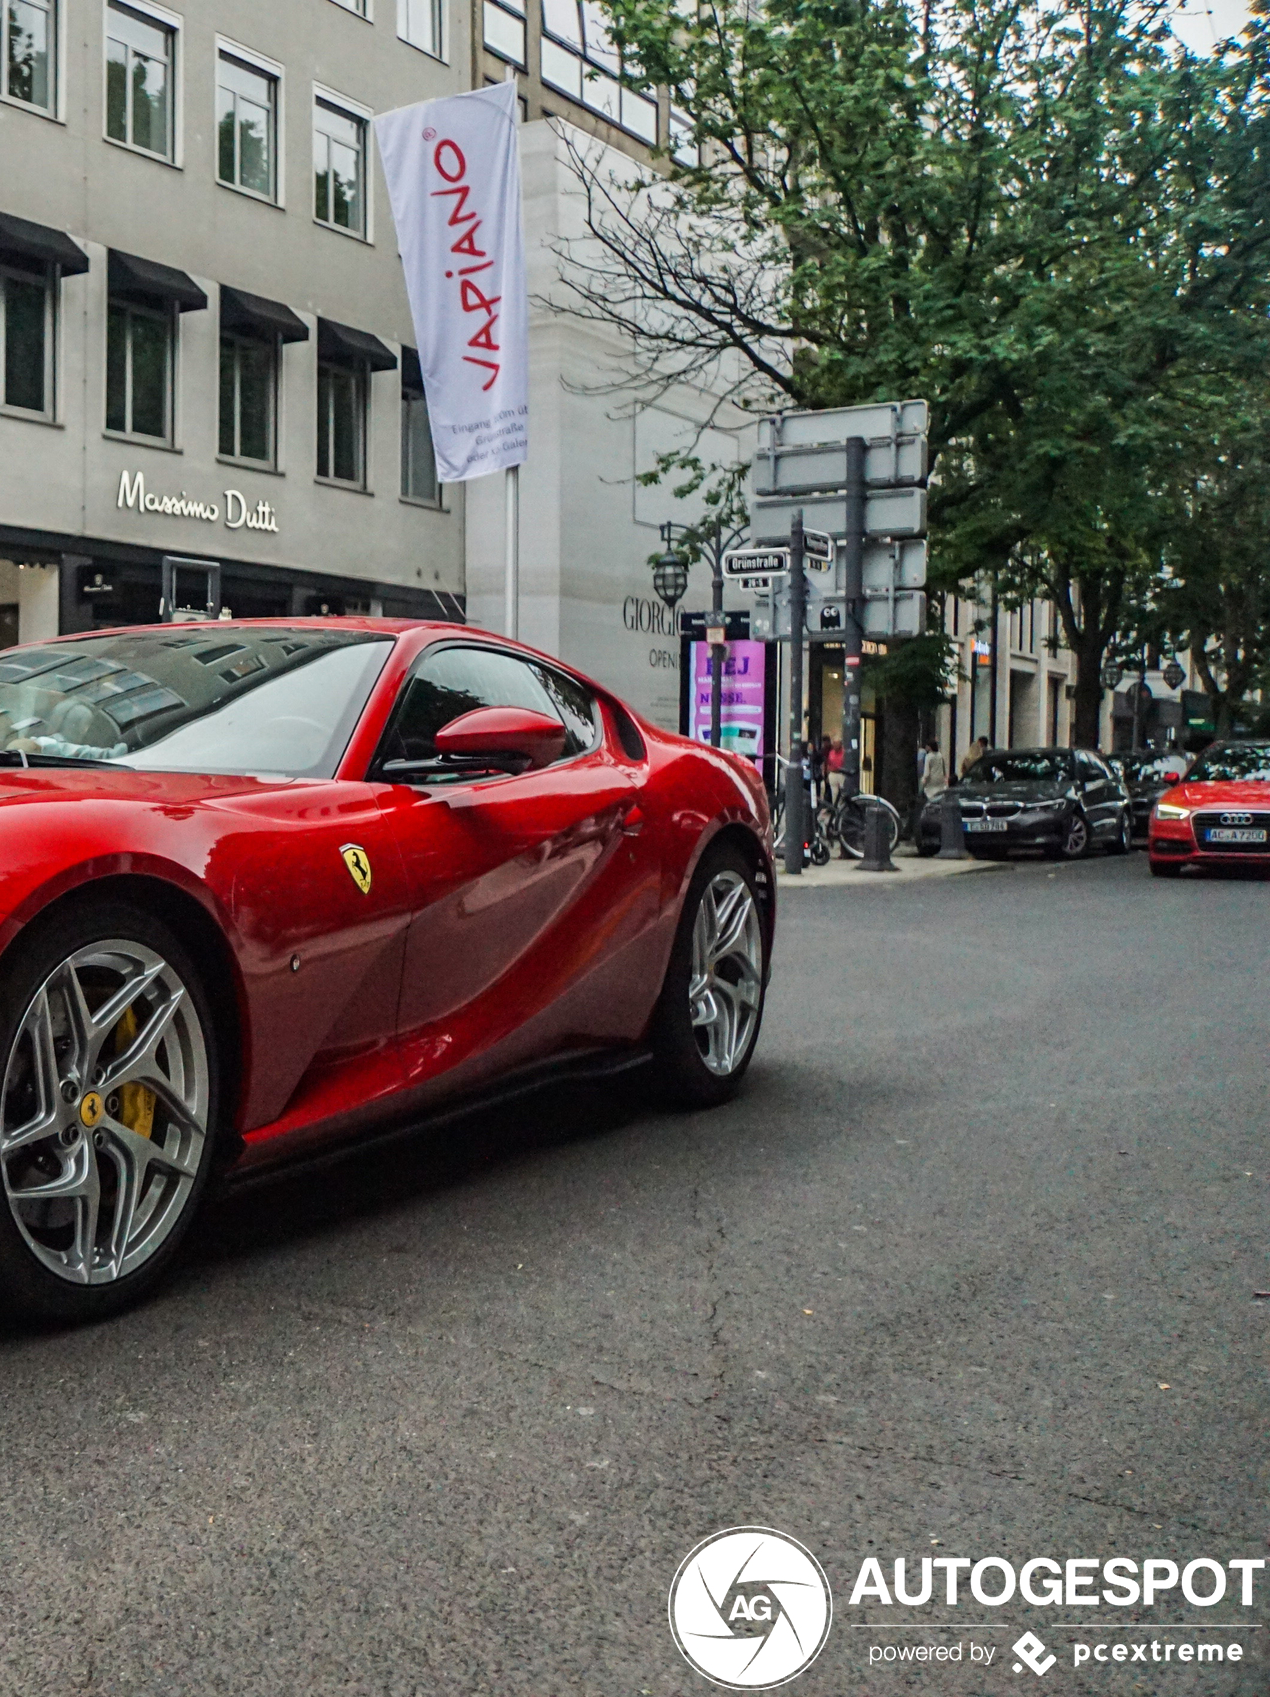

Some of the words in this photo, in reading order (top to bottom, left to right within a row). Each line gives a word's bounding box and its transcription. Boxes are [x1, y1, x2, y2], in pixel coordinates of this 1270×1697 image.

[451, 419, 492, 435] Eingang
[117, 469, 220, 522] Massimo
[223, 489, 279, 533] Dutti
[732, 555, 779, 570] Grünstraße
